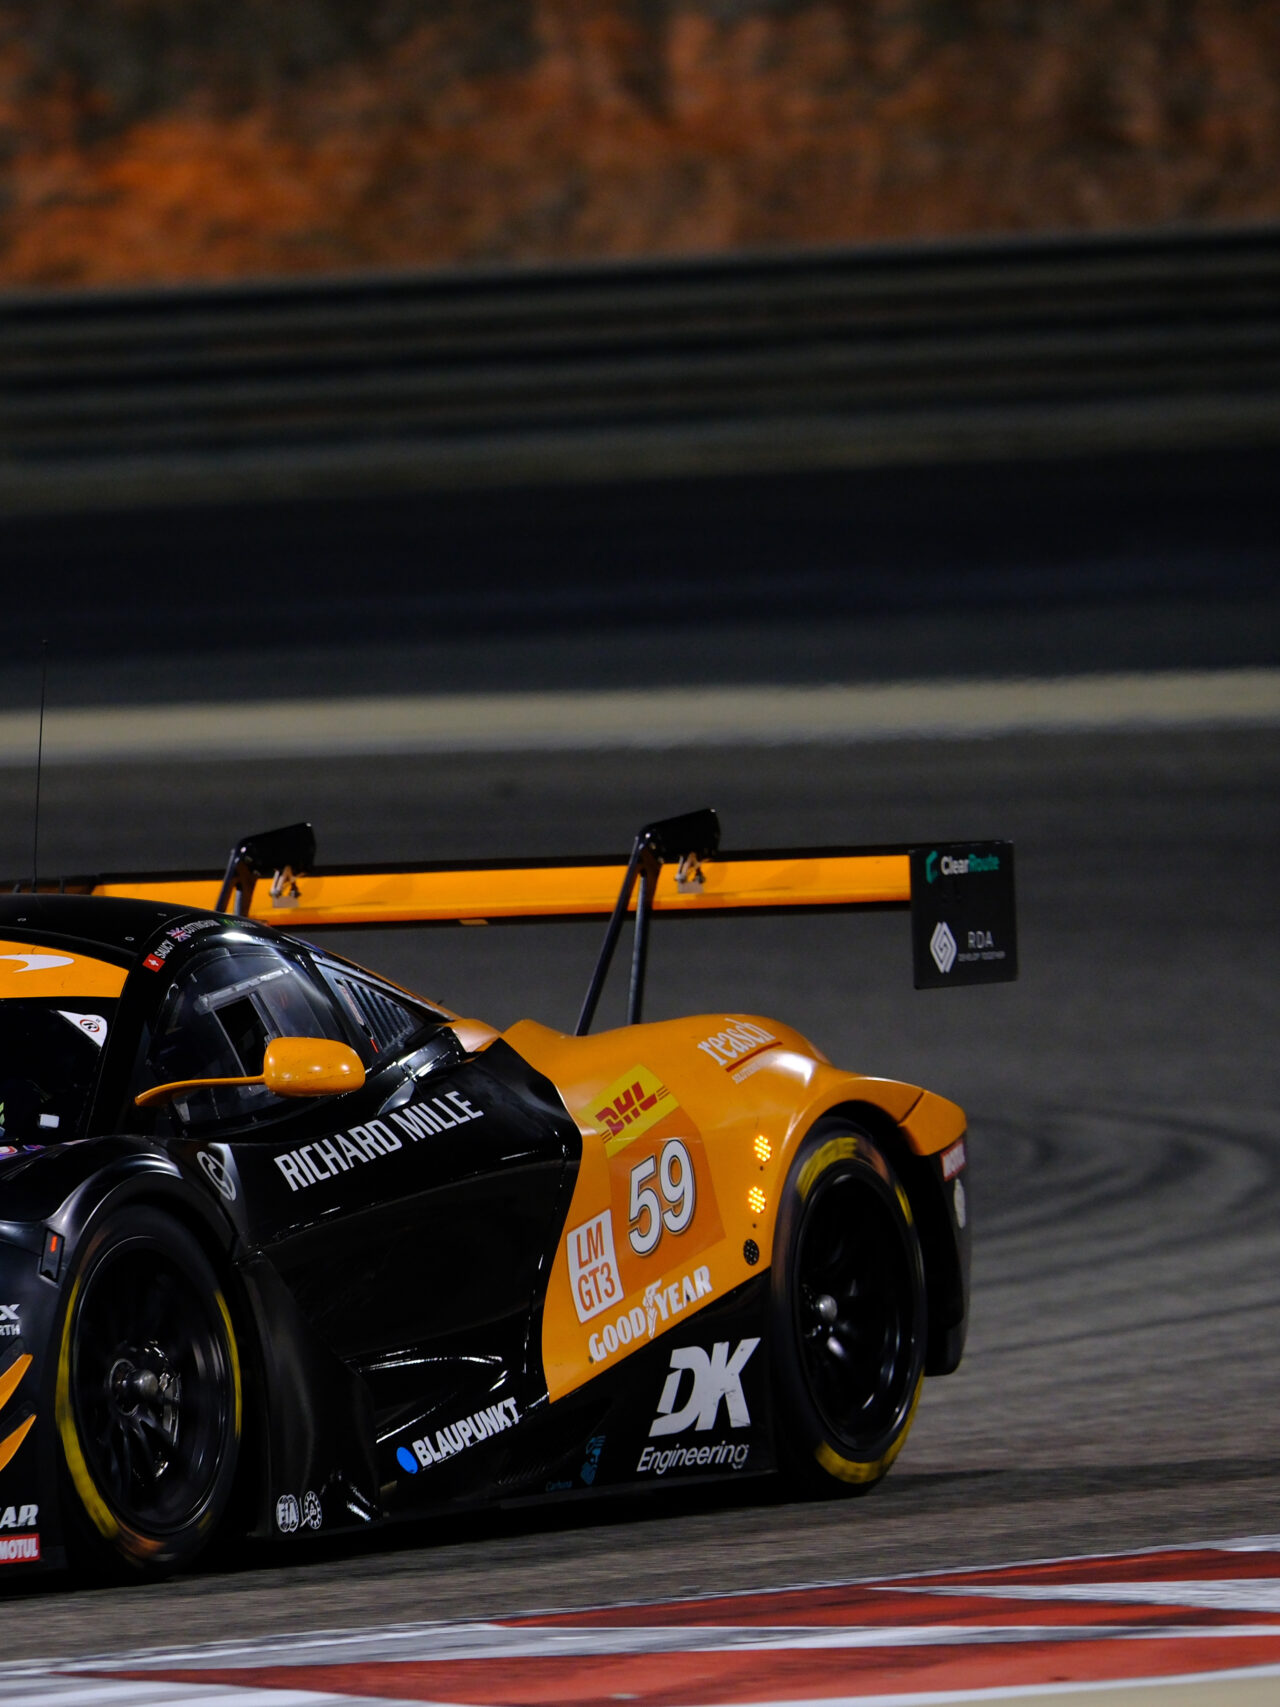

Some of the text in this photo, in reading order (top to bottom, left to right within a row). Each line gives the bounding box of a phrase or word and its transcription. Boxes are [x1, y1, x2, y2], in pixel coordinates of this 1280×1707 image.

[968, 931, 994, 949] RDA
[595, 1081, 658, 1137] DHL
[274, 1090, 485, 1192] RICHARD MILLE
[628, 1138, 696, 1256] 59
[576, 1221, 605, 1269] LM
[577, 1262, 616, 1312] GT3
[649, 1337, 762, 1438] DK
[412, 1397, 520, 1467] BLAUPUNKT
[637, 1440, 750, 1475] Engineering
